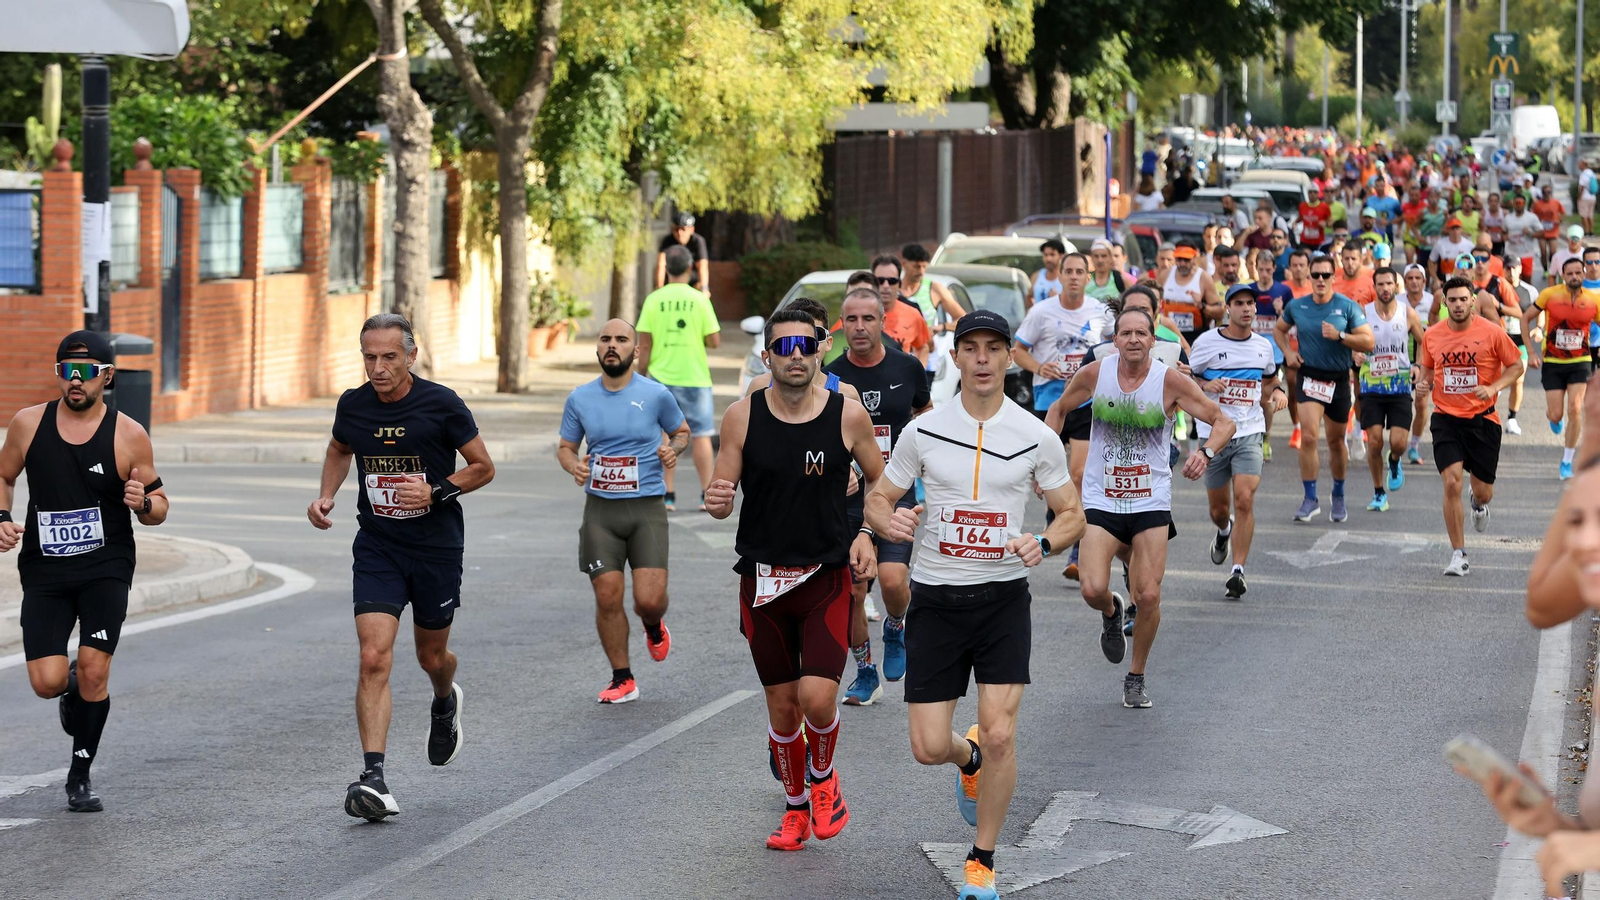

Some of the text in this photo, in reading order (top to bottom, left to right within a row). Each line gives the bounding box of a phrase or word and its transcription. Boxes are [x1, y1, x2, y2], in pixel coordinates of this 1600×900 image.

[660, 301, 694, 311] STAFF
[1441, 351, 1477, 365] XXIX
[1376, 361, 1392, 370] 403
[1451, 376, 1469, 386] 396
[1228, 388, 1248, 398] 448
[374, 427, 406, 438] JTC
[1102, 445, 1115, 462] Los
[364, 458, 422, 472] RAMSES II
[600, 468, 626, 481] 464
[1115, 477, 1139, 489] 531
[50, 525, 93, 542] 1002
[956, 526, 991, 545] 164
